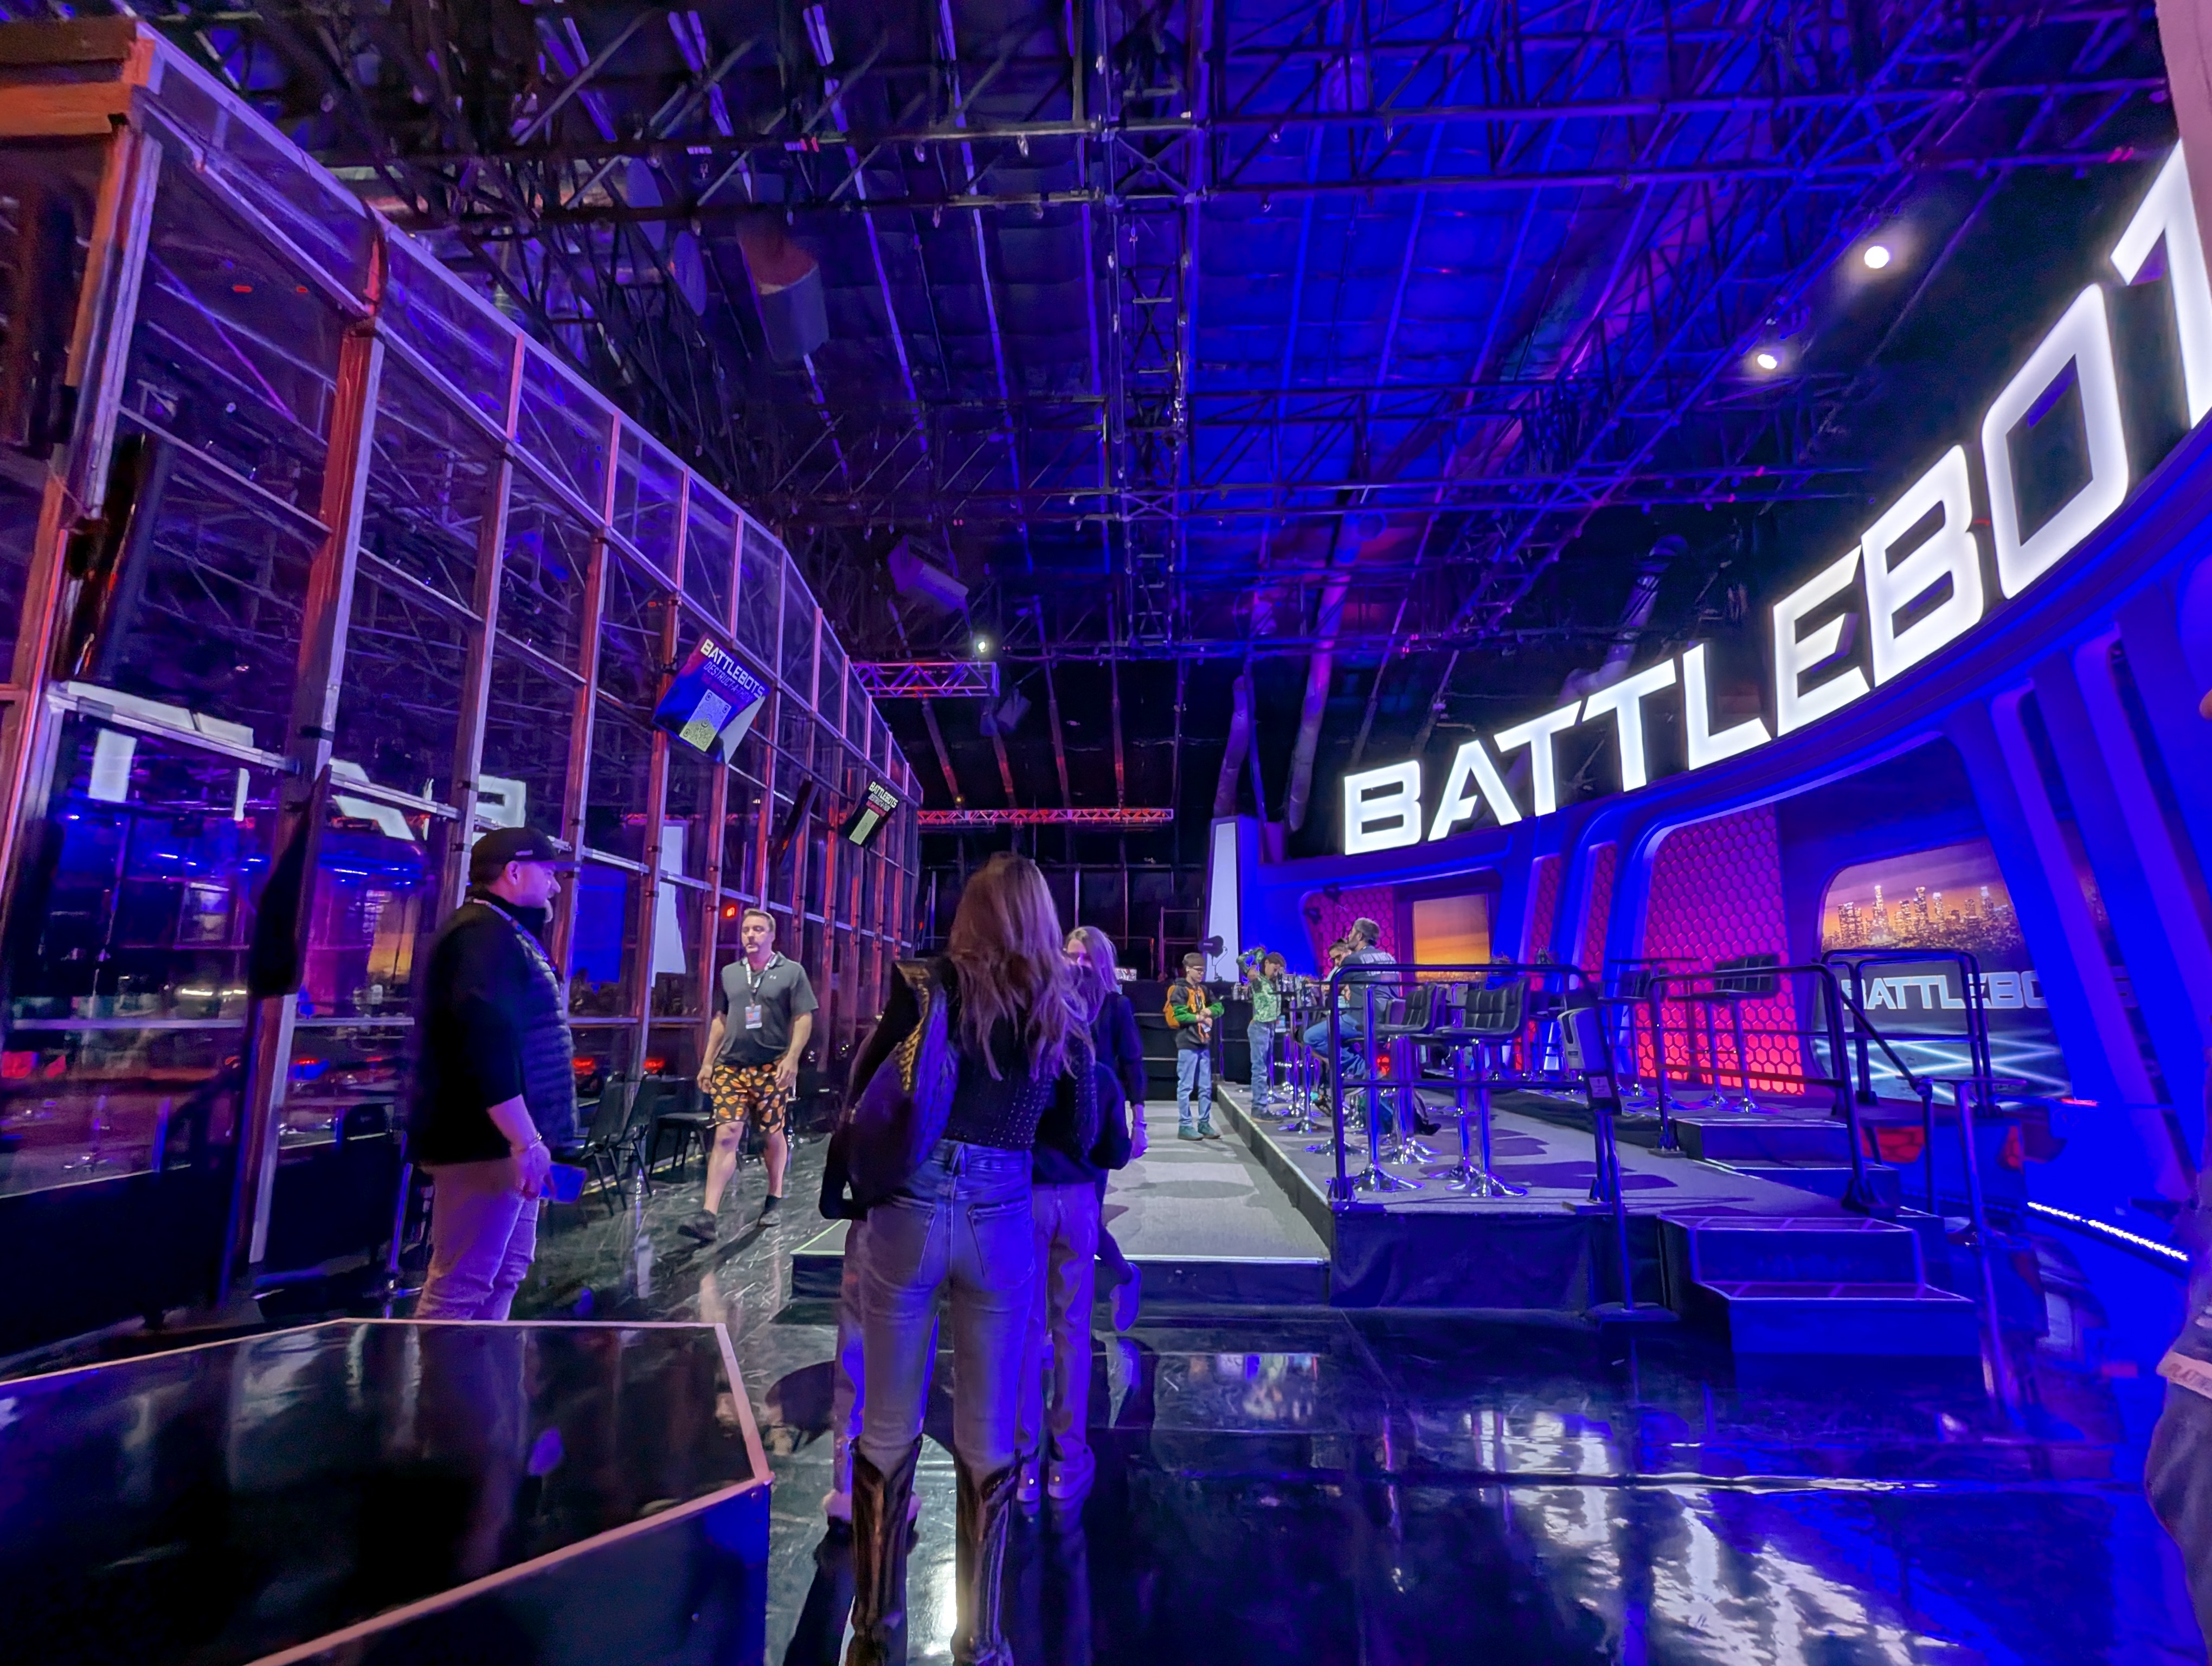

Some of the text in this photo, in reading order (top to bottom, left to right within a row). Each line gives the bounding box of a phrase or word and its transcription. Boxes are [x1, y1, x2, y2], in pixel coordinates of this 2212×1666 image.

[700, 638, 765, 699] BATTLEBOTS
[703, 661, 753, 702] DESTRUCT-A-THON
[869, 781, 898, 809] BATTLEBOTS
